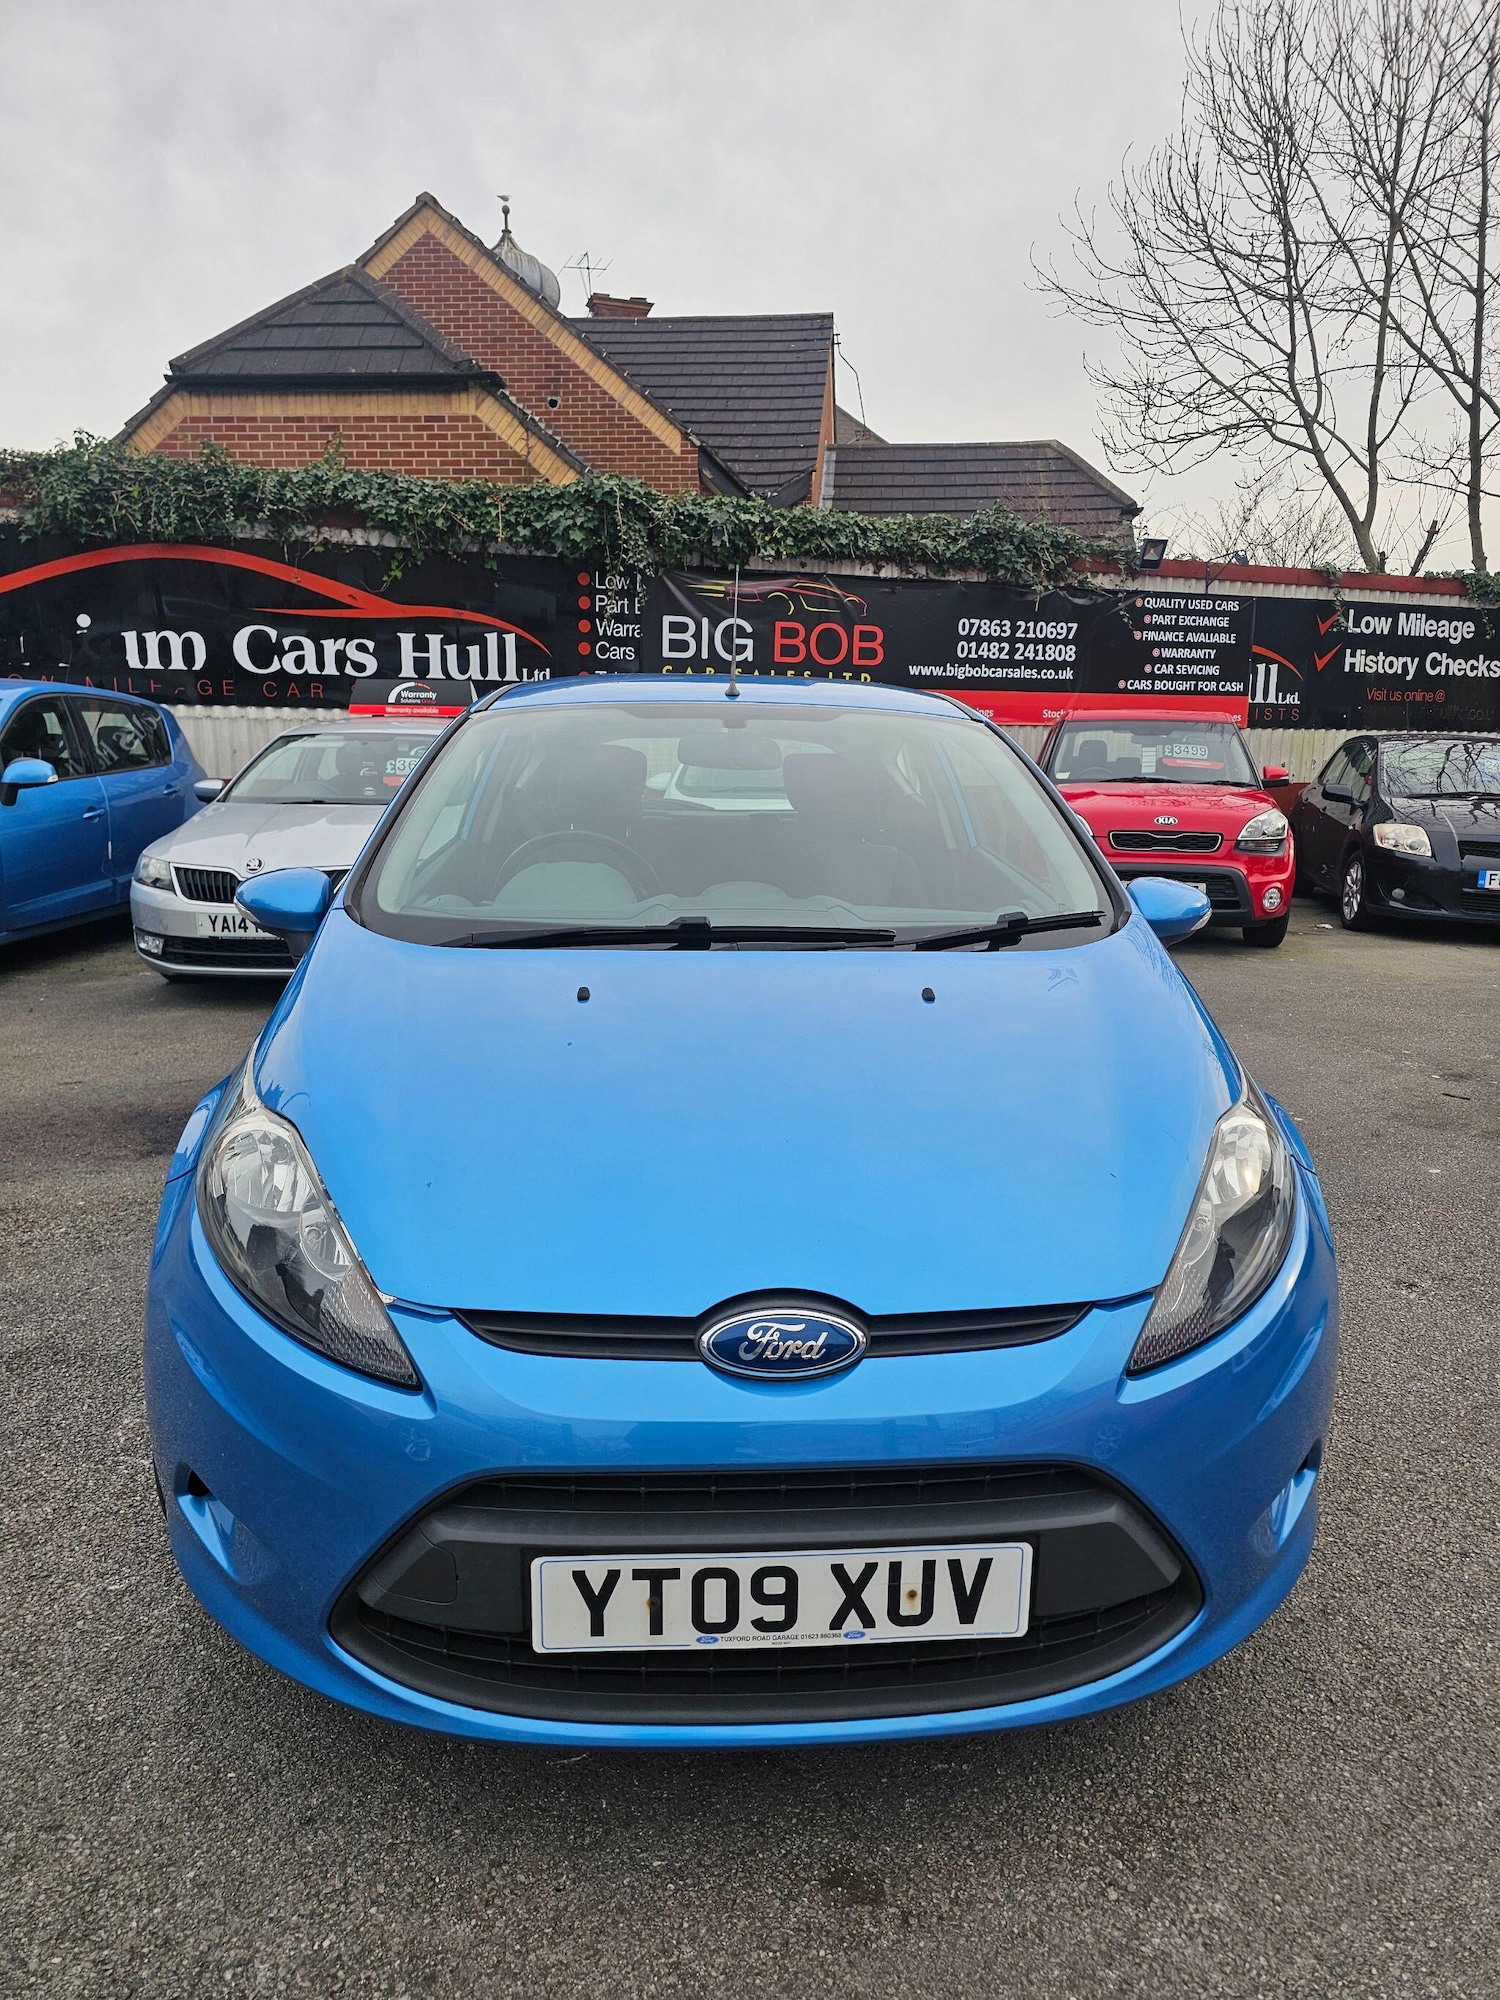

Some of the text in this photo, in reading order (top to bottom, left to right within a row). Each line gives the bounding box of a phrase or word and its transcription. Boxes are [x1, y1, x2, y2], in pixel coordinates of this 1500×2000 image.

[595, 594, 628, 614] Part
[1144, 597, 1239, 611] QUALITY USED CARS
[958, 618, 1078, 639] 07863 210697
[1152, 614, 1229, 627] PART EXCHANGE
[1348, 609, 1475, 645] Low Mileage
[662, 615, 884, 666] BIG BOB
[1142, 630, 1236, 643] FINANCE AVALIABLE
[232, 624, 378, 677] Cars
[397, 632, 521, 681] Hull
[595, 641, 635, 660] Cars
[957, 641, 1076, 661] 01482 241808
[1161, 648, 1216, 659] WARRANTY
[909, 663, 1074, 679] www.bigbobcarsales.co.uk
[1154, 664, 1220, 675] CAR SEVICING
[1344, 649, 1500, 680] History Checks
[262, 681, 324, 699] CAR
[1127, 680, 1243, 692] CARS BOUGHT FOR CASH
[400, 691, 437, 701] Warranty
[1278, 692, 1300, 704] Ltd.
[1367, 688, 1446, 702] Visit us online @
[386, 706, 412, 714] Warranty
[1164, 744, 1207, 757] £3499
[208, 914, 248, 933] YA14
[738, 1322, 829, 1361] Ford
[572, 1557, 993, 1637] YT09 XUV
